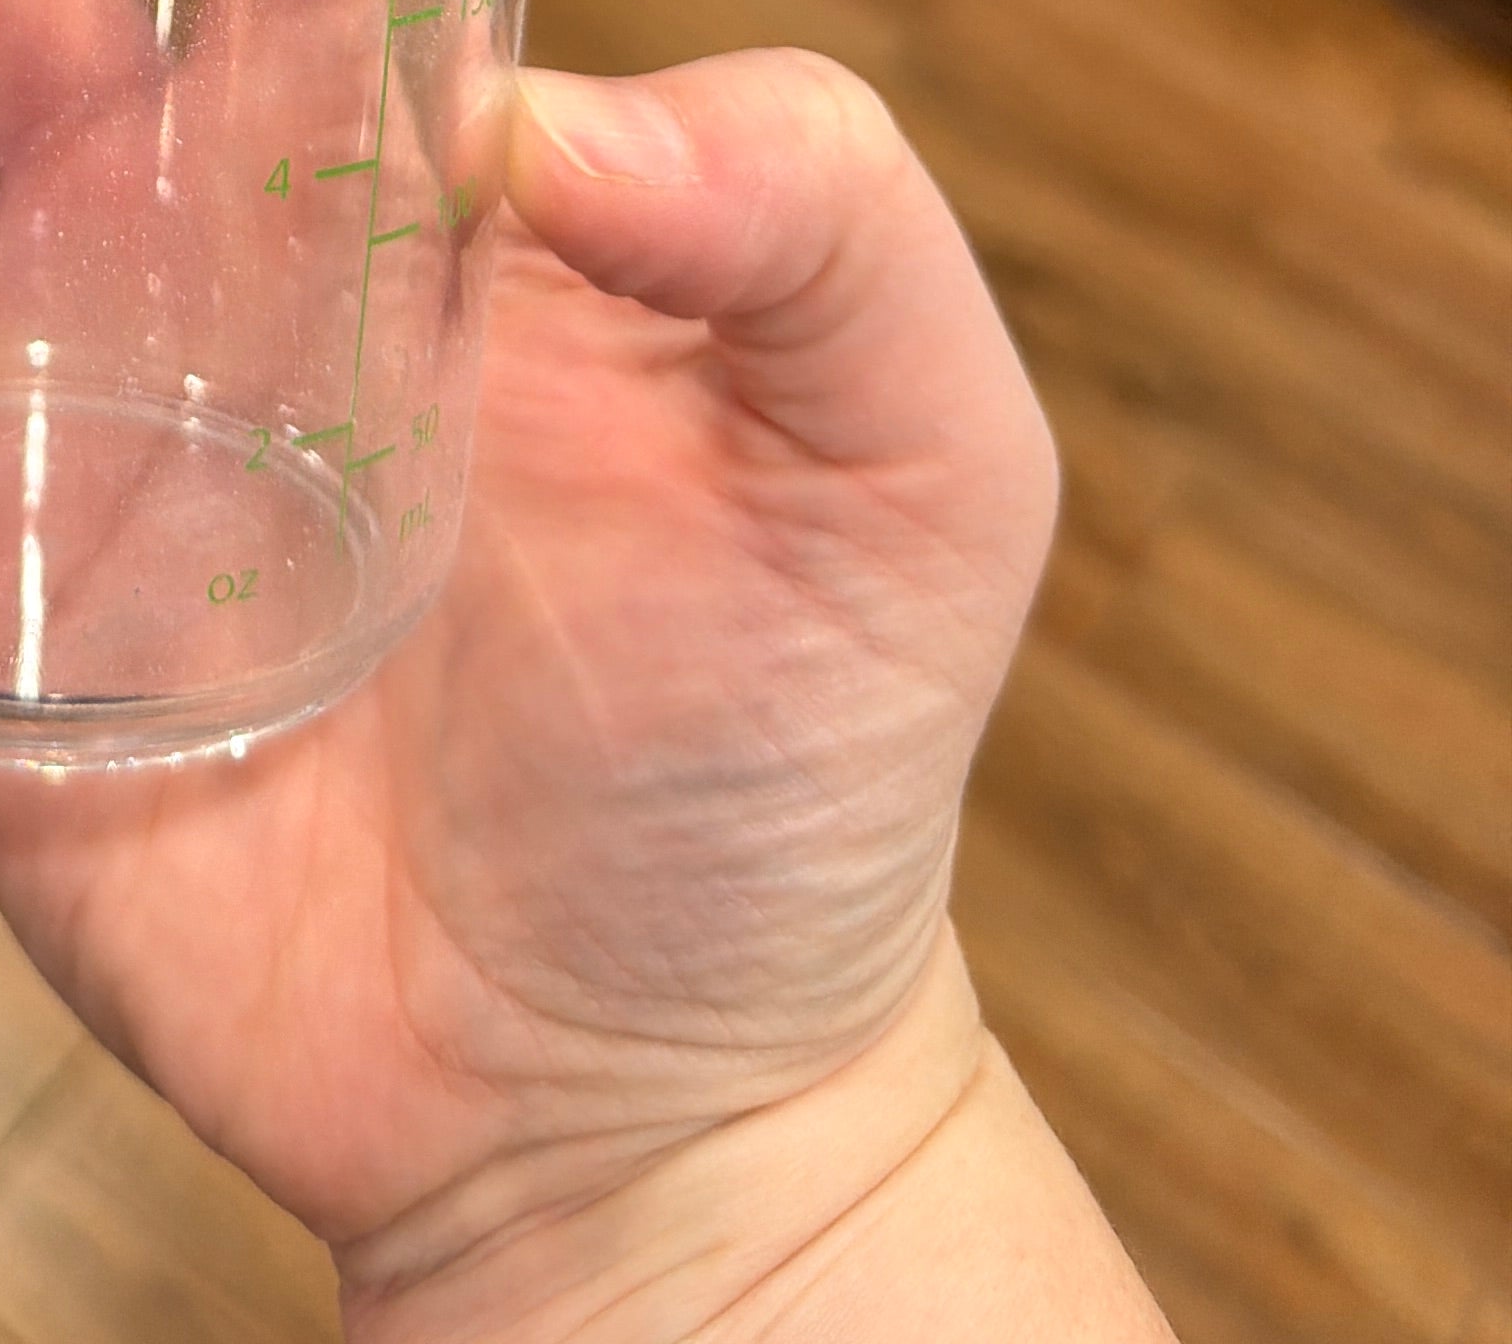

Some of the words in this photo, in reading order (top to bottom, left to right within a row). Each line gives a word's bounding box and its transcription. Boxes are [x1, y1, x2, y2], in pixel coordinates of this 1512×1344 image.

[263, 158, 290, 200] 4
[410, 402, 440, 453] 50
[245, 428, 272, 472] 2
